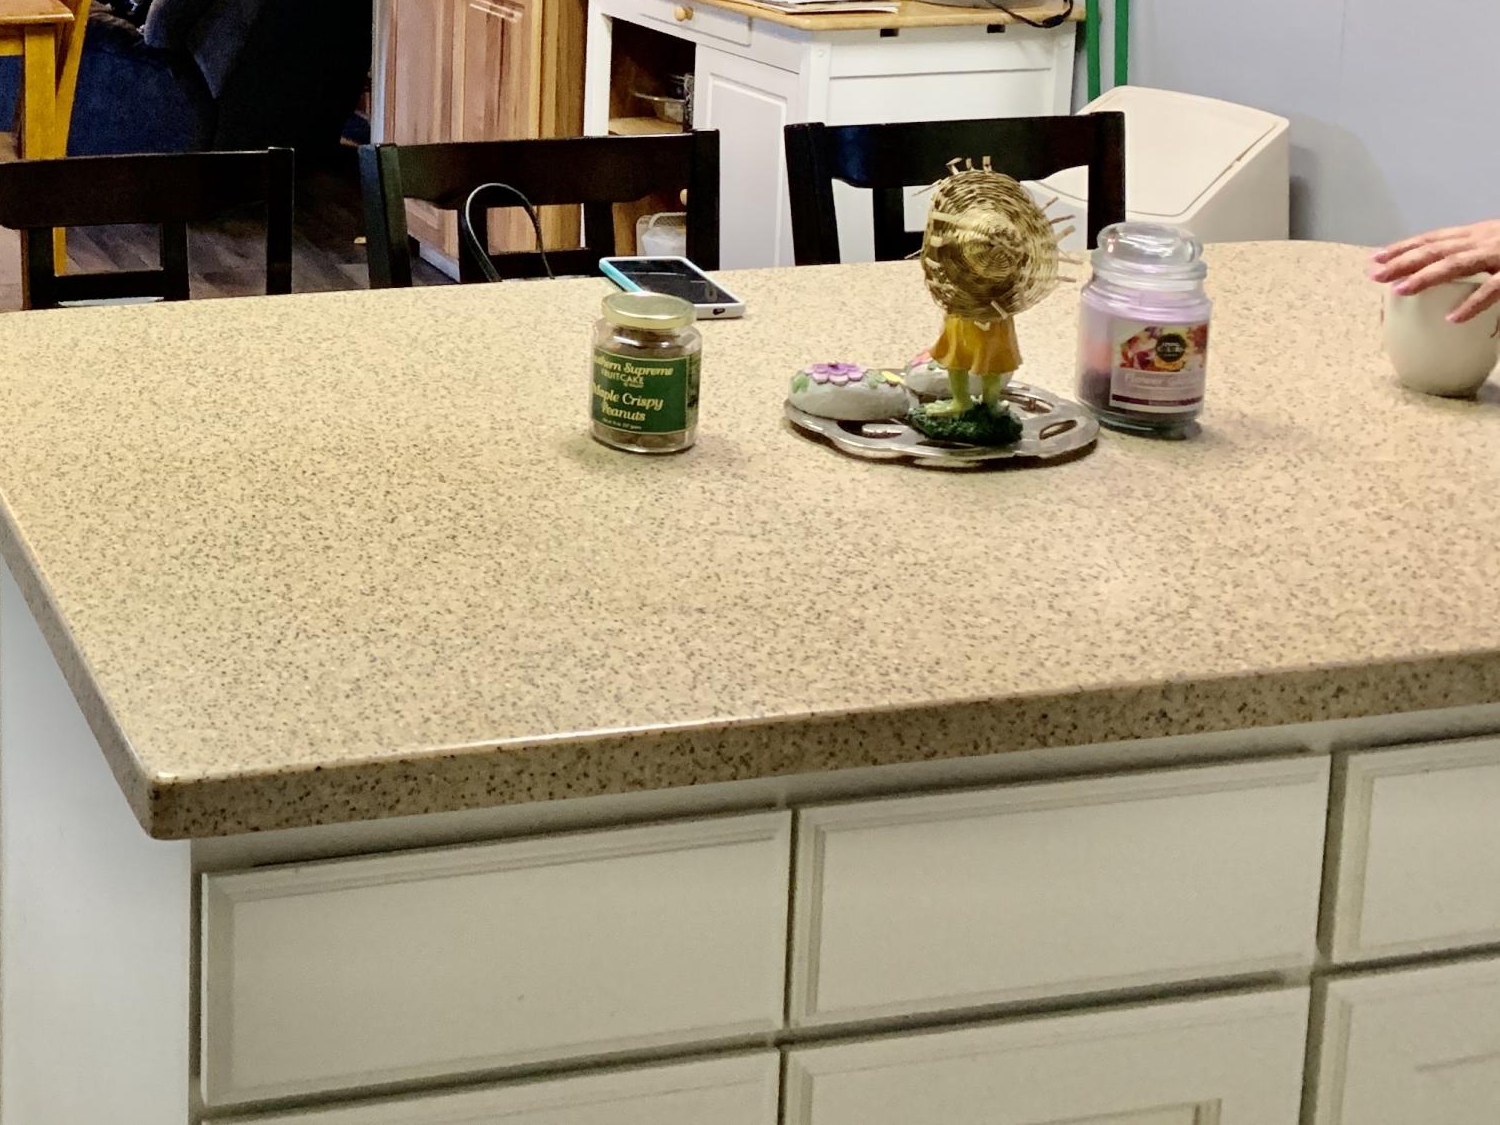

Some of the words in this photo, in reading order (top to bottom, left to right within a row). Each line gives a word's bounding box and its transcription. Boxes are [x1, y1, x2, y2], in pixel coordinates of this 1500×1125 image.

[623, 362, 674, 379] Supreme
[602, 401, 646, 421] Peanuts
[622, 392, 664, 411] Crispy
